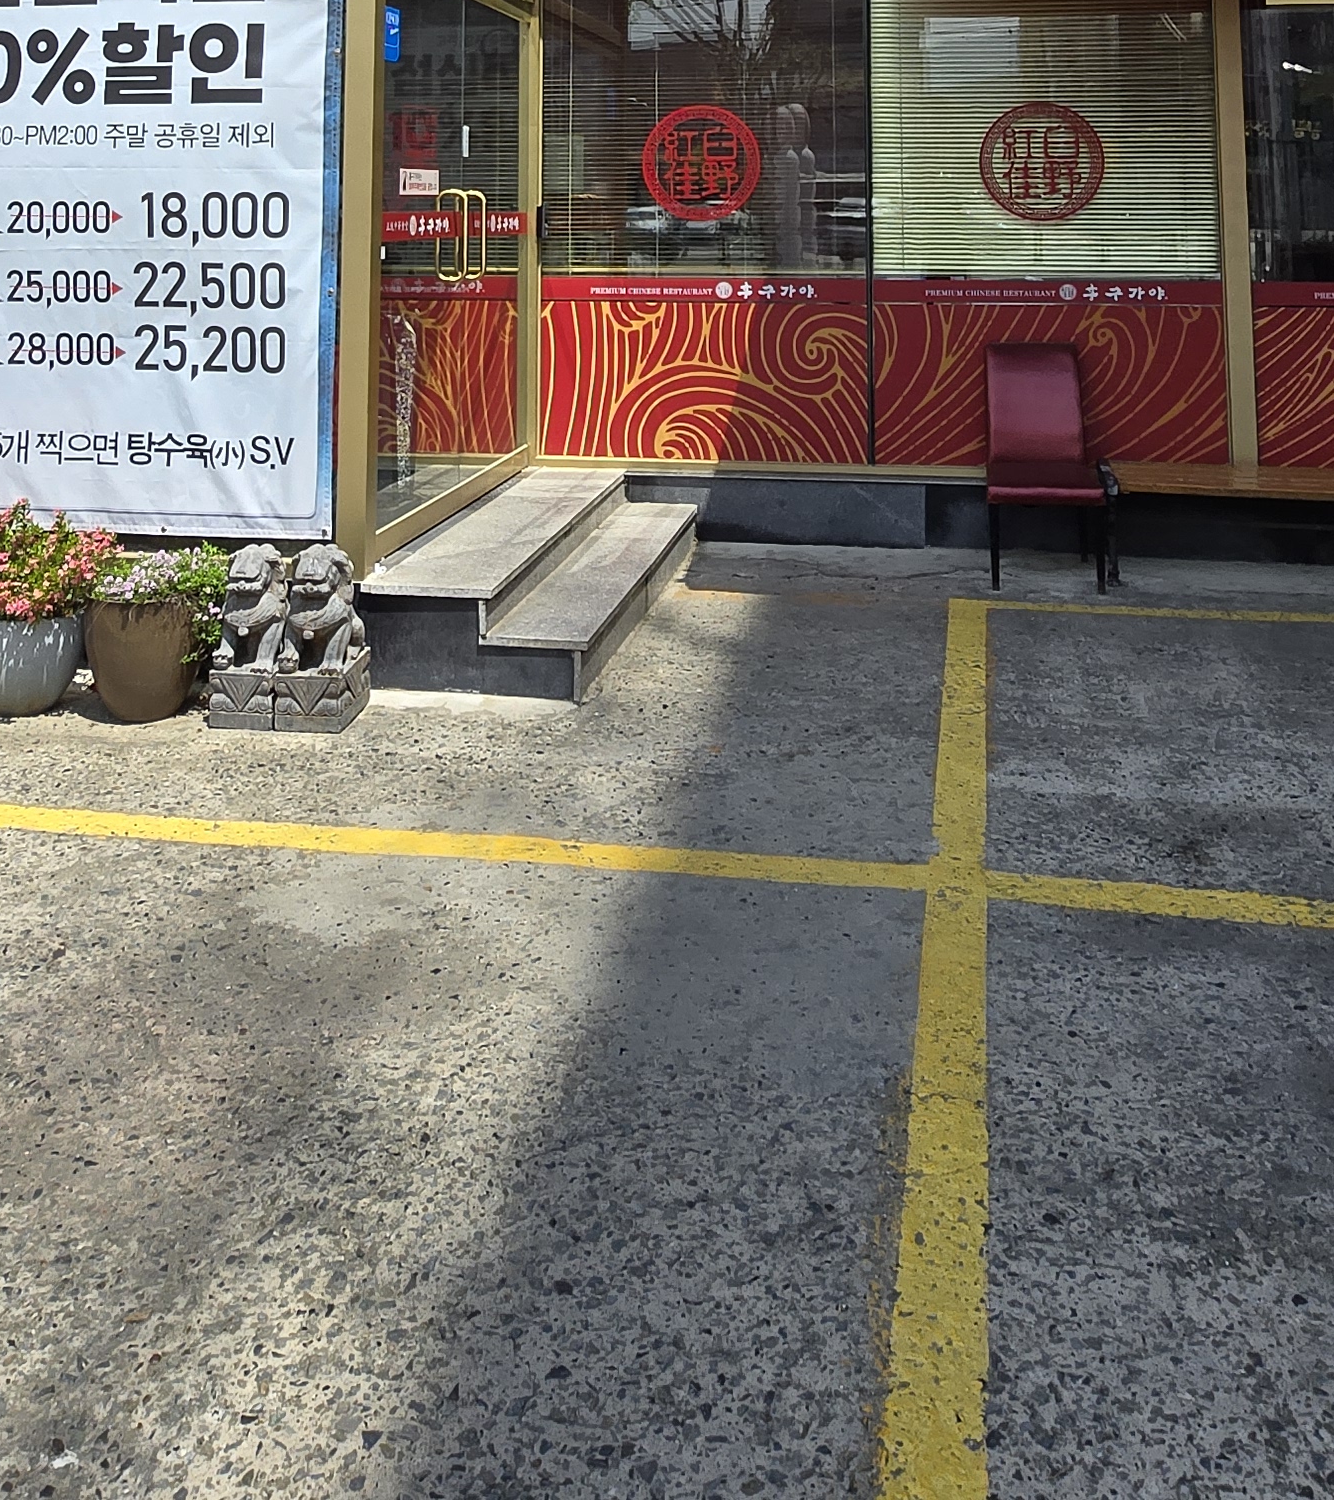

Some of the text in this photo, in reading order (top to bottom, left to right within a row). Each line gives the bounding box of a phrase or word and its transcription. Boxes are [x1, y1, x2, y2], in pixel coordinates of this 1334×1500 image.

[102, 123, 149, 149] 주말
[153, 123, 222, 149] 공휴일
[227, 121, 276, 149] 제외
[140, 191, 290, 248] 18,000
[132, 261, 286, 317] 22,500
[590, 287, 627, 295] PREMIUM
[628, 288, 661, 296] CHINESE
[663, 288, 713, 296] RESTAURANT
[925, 289, 964, 297] PREMIUM
[965, 289, 1001, 297] CHINESE
[1003, 289, 1057, 298] RESTAURANT
[134, 324, 287, 381] 25,200
[34, 430, 119, 466] 찍으면
[249, 436, 295, 471] S.V
